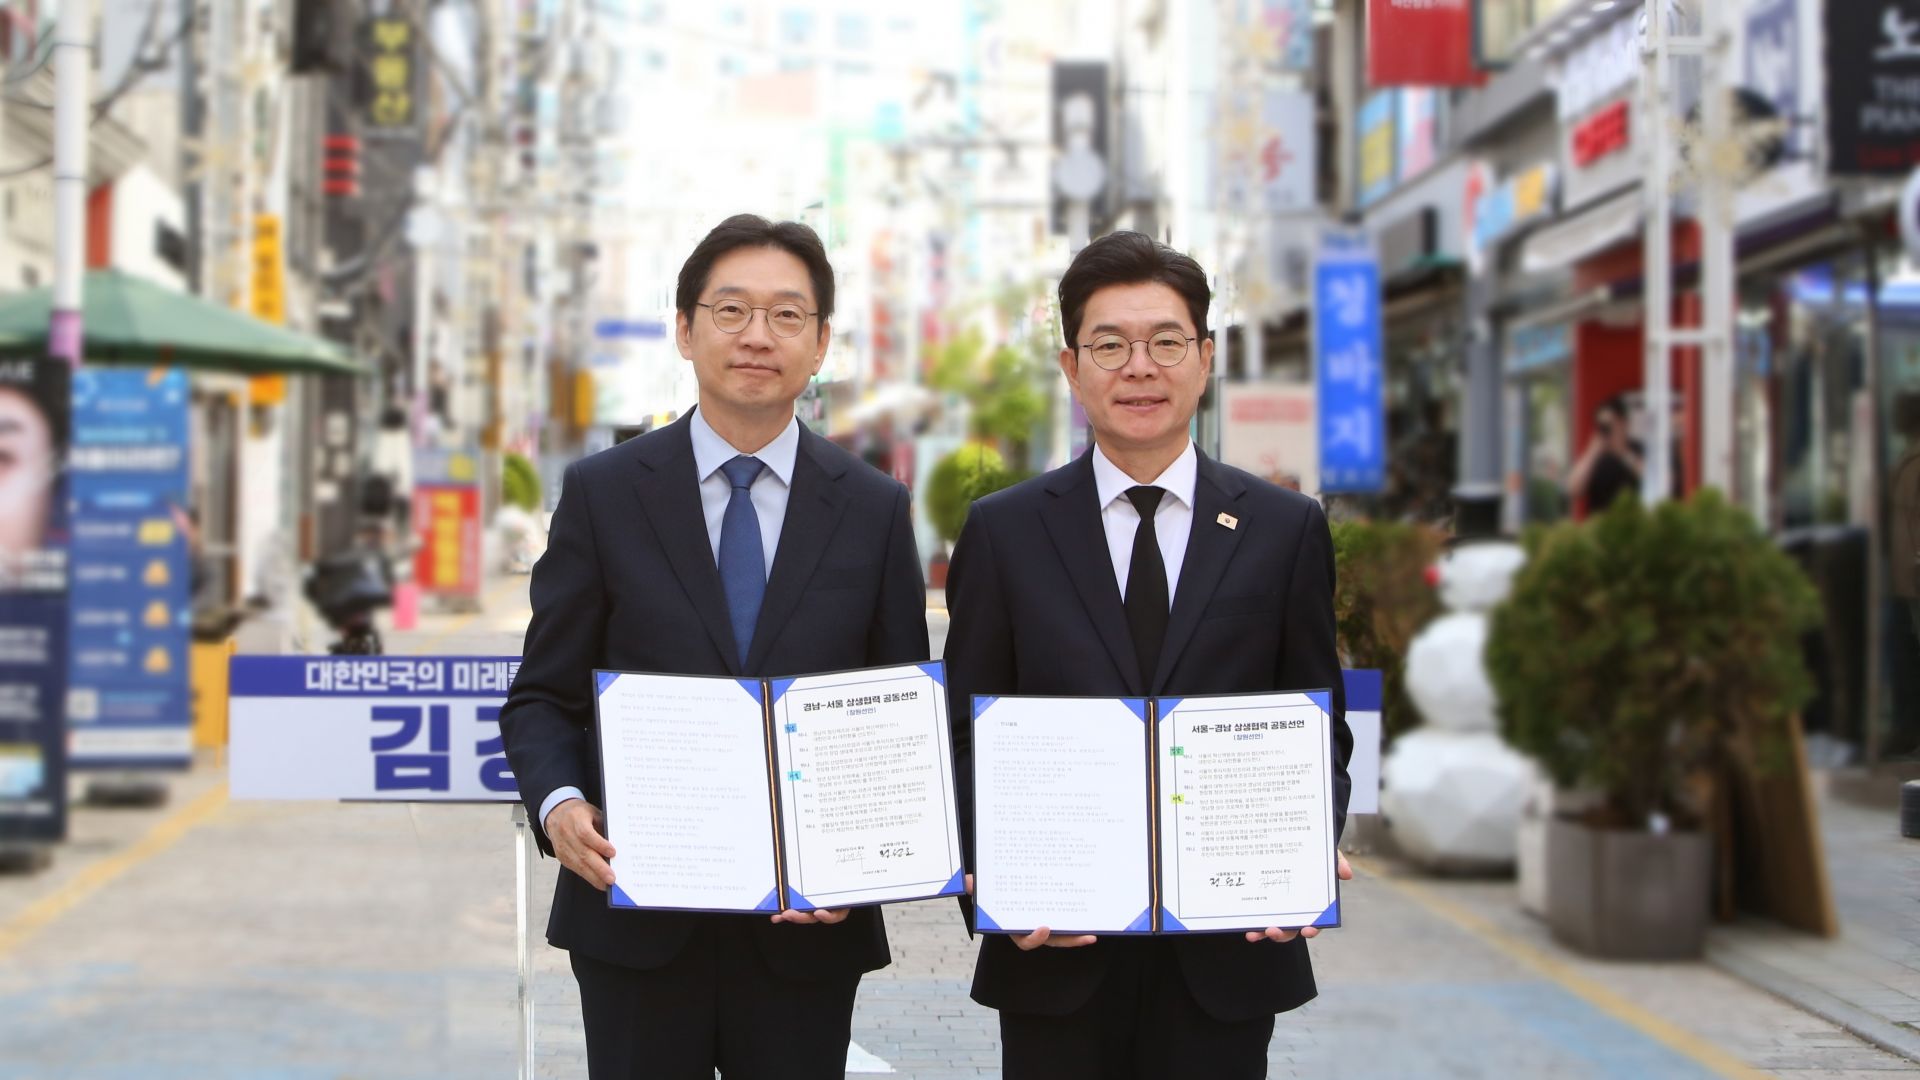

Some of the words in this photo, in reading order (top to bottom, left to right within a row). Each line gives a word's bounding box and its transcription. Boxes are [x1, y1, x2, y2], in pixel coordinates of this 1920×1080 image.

[305, 660, 445, 692] 대한민국의
[803, 699, 844, 712] 경남-서울
[846, 695, 880, 707] 상생협력
[883, 691, 918, 703] 공동선언
[1192, 723, 1231, 734] 서울-경남
[1234, 722, 1268, 732] 상생협력
[1270, 720, 1305, 730] 공동선언
